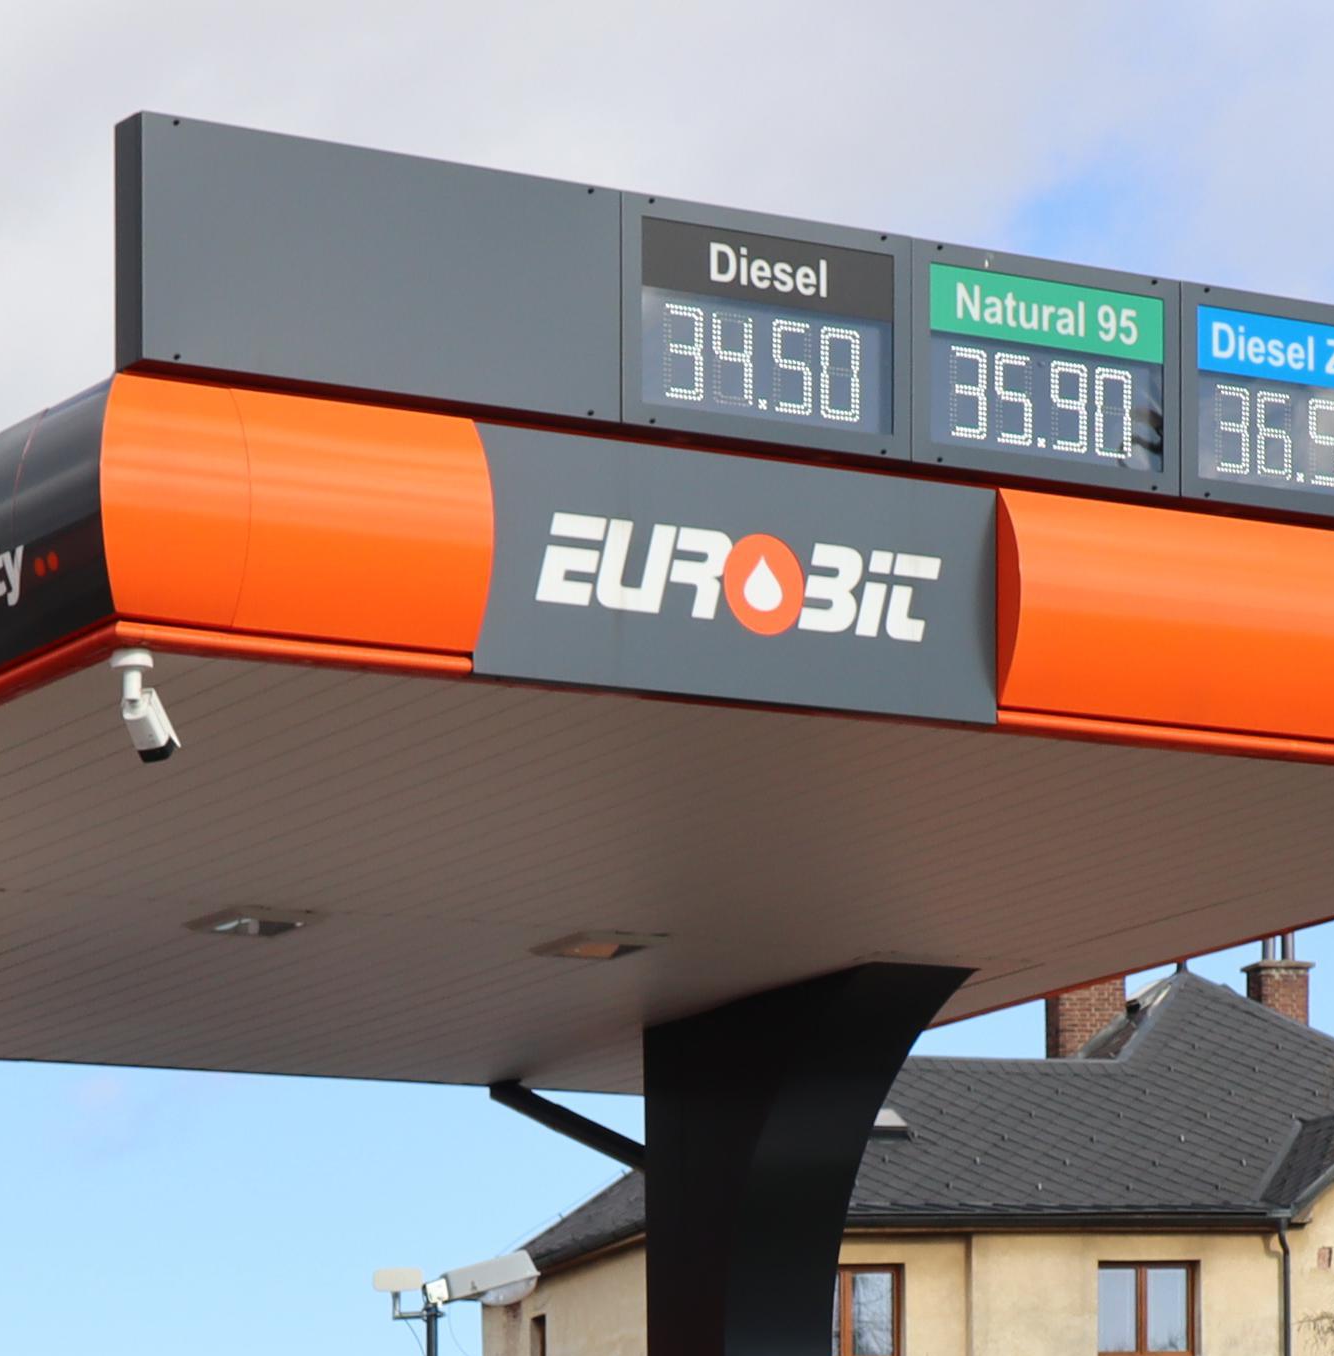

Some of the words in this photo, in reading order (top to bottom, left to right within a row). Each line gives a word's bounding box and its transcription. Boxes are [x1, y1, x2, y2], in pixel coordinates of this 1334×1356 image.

[709, 240, 828, 298] Diesel
[955, 281, 1086, 338] Natural
[1096, 303, 1139, 346] 95
[665, 302, 861, 423] 34.50
[1211, 320, 1316, 372] Diesel
[950, 344, 1133, 460] 35.90
[534, 510, 943, 643] EUROBIT
